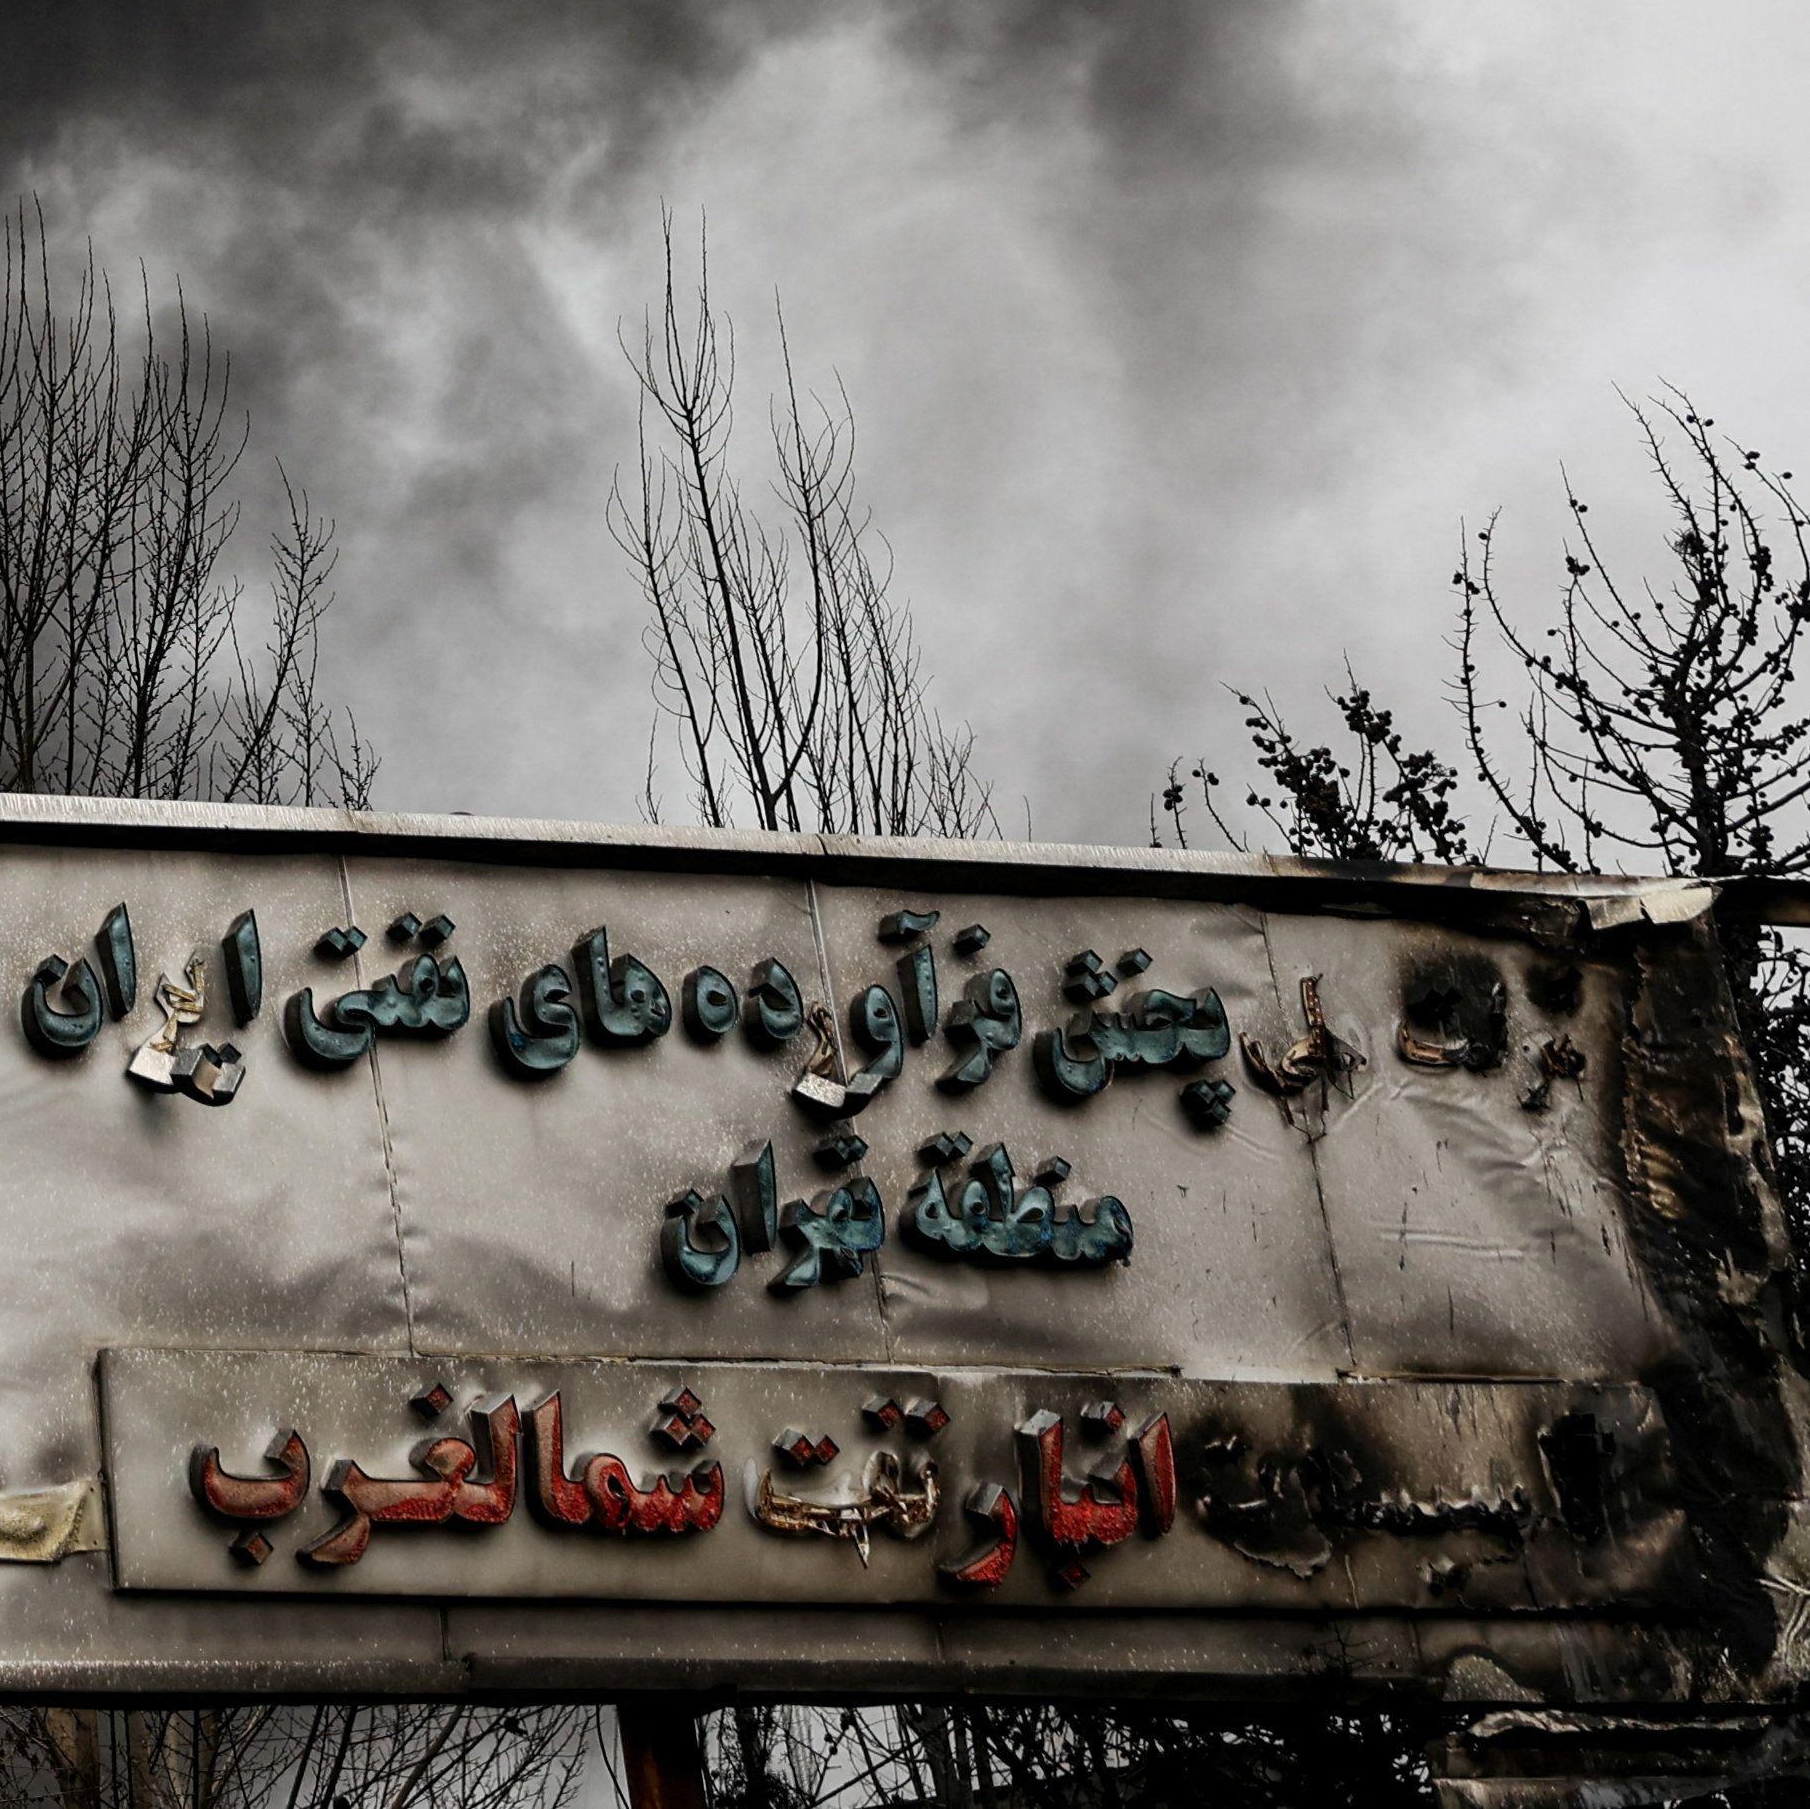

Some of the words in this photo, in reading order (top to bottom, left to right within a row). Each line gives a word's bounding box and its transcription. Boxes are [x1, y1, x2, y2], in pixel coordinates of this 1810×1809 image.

[22, 900, 263, 1107] ایران
[281, 910, 472, 1072] نفتی
[1033, 948, 1239, 1128] پخش
[661, 1138, 885, 1298] تهران
[899, 1130, 1134, 1266] منطقه
[937, 1408, 1177, 1592] انبار
